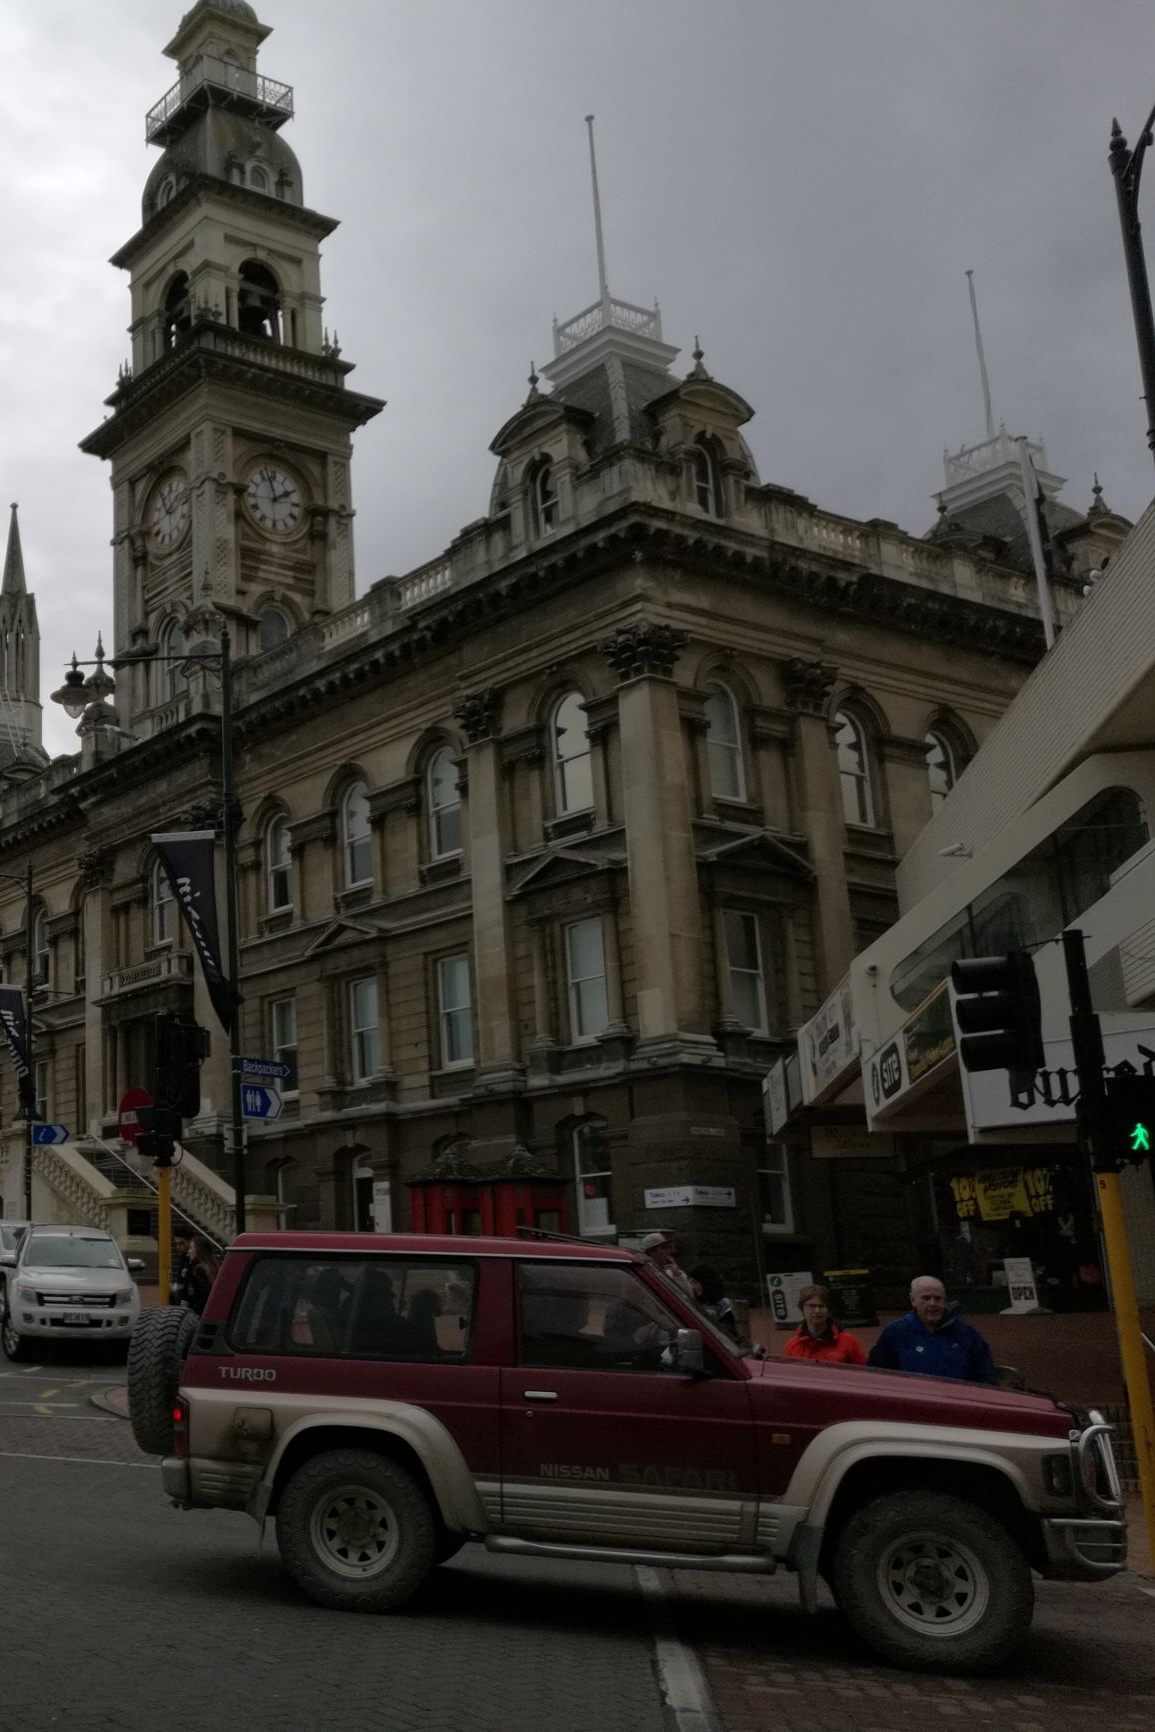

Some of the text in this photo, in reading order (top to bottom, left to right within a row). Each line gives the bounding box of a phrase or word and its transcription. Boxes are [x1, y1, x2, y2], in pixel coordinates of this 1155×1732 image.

[242, 1059, 284, 1077] Backpackers
[1011, 1286, 1035, 1300] OPEN
[217, 1366, 277, 1382] TURBO
[539, 1462, 740, 1491] NISSAN SAFARI
